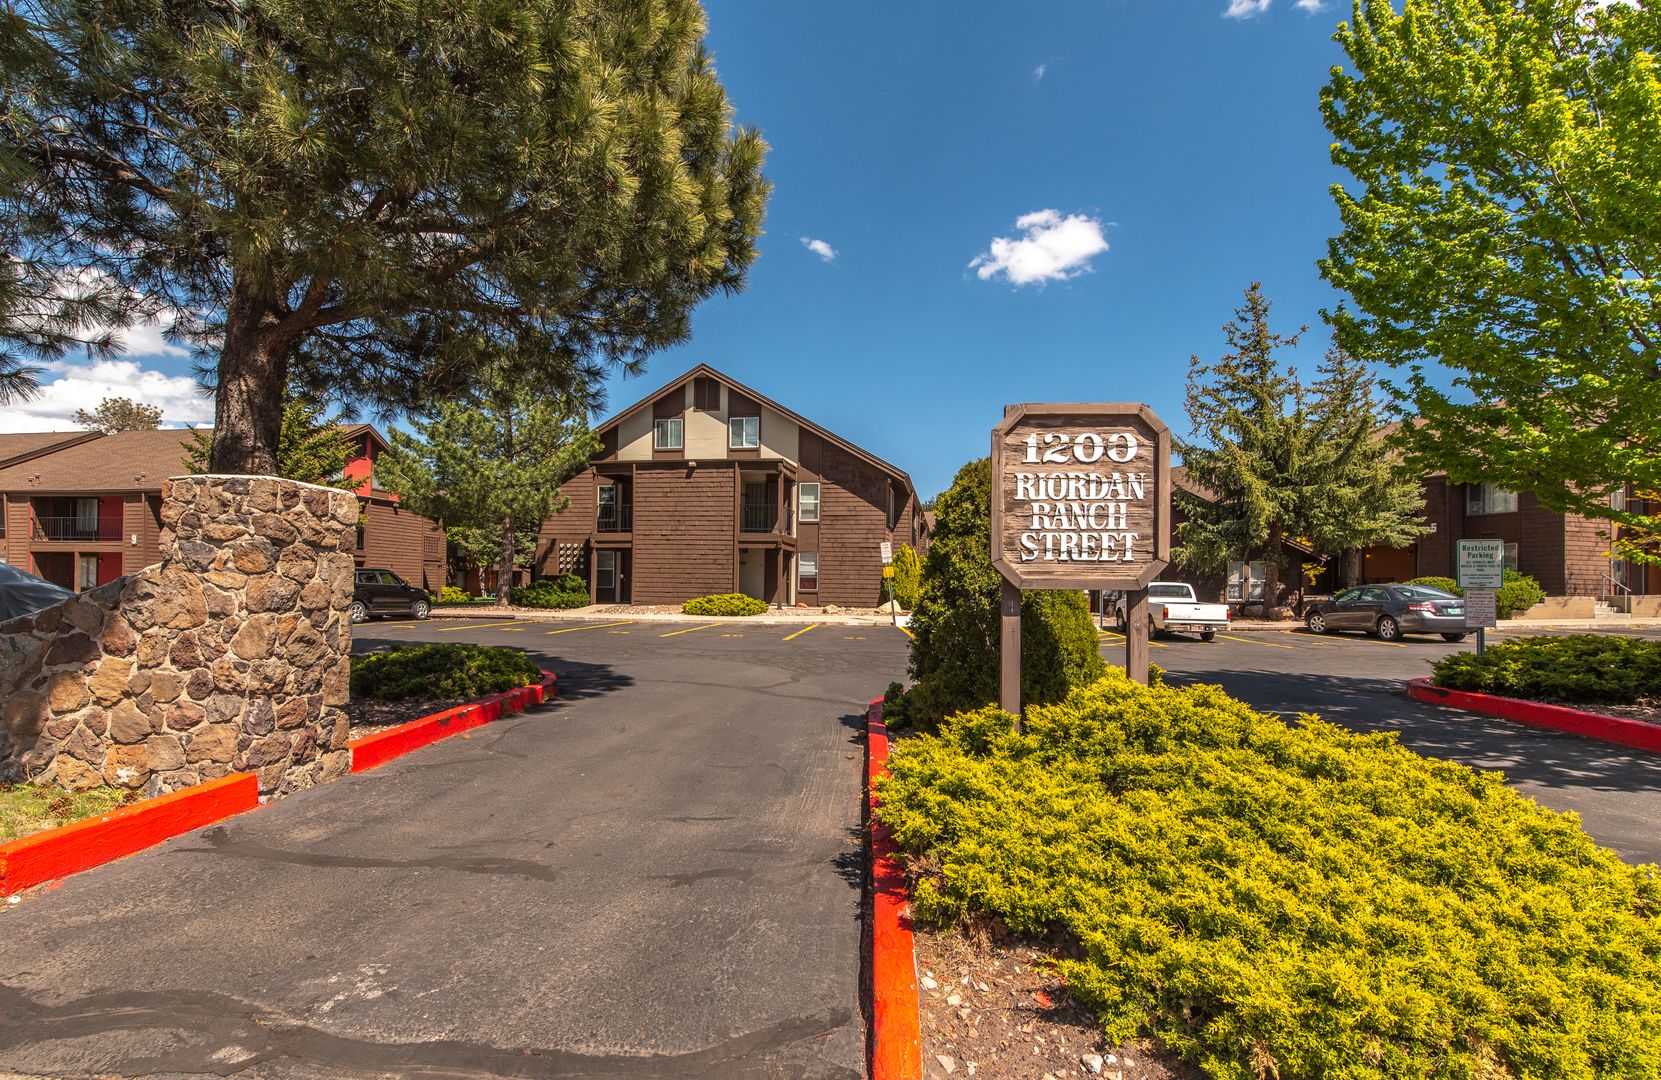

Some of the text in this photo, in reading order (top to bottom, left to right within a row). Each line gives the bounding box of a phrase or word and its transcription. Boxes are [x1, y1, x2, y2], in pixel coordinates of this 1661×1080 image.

[1021, 432, 1138, 464] 1200
[1014, 472, 1146, 500] RIORDAN
[1030, 502, 1129, 530] RANCH
[1430, 523, 1437, 532] 5
[131, 534, 137, 545] 9
[1020, 532, 1139, 562] STREET
